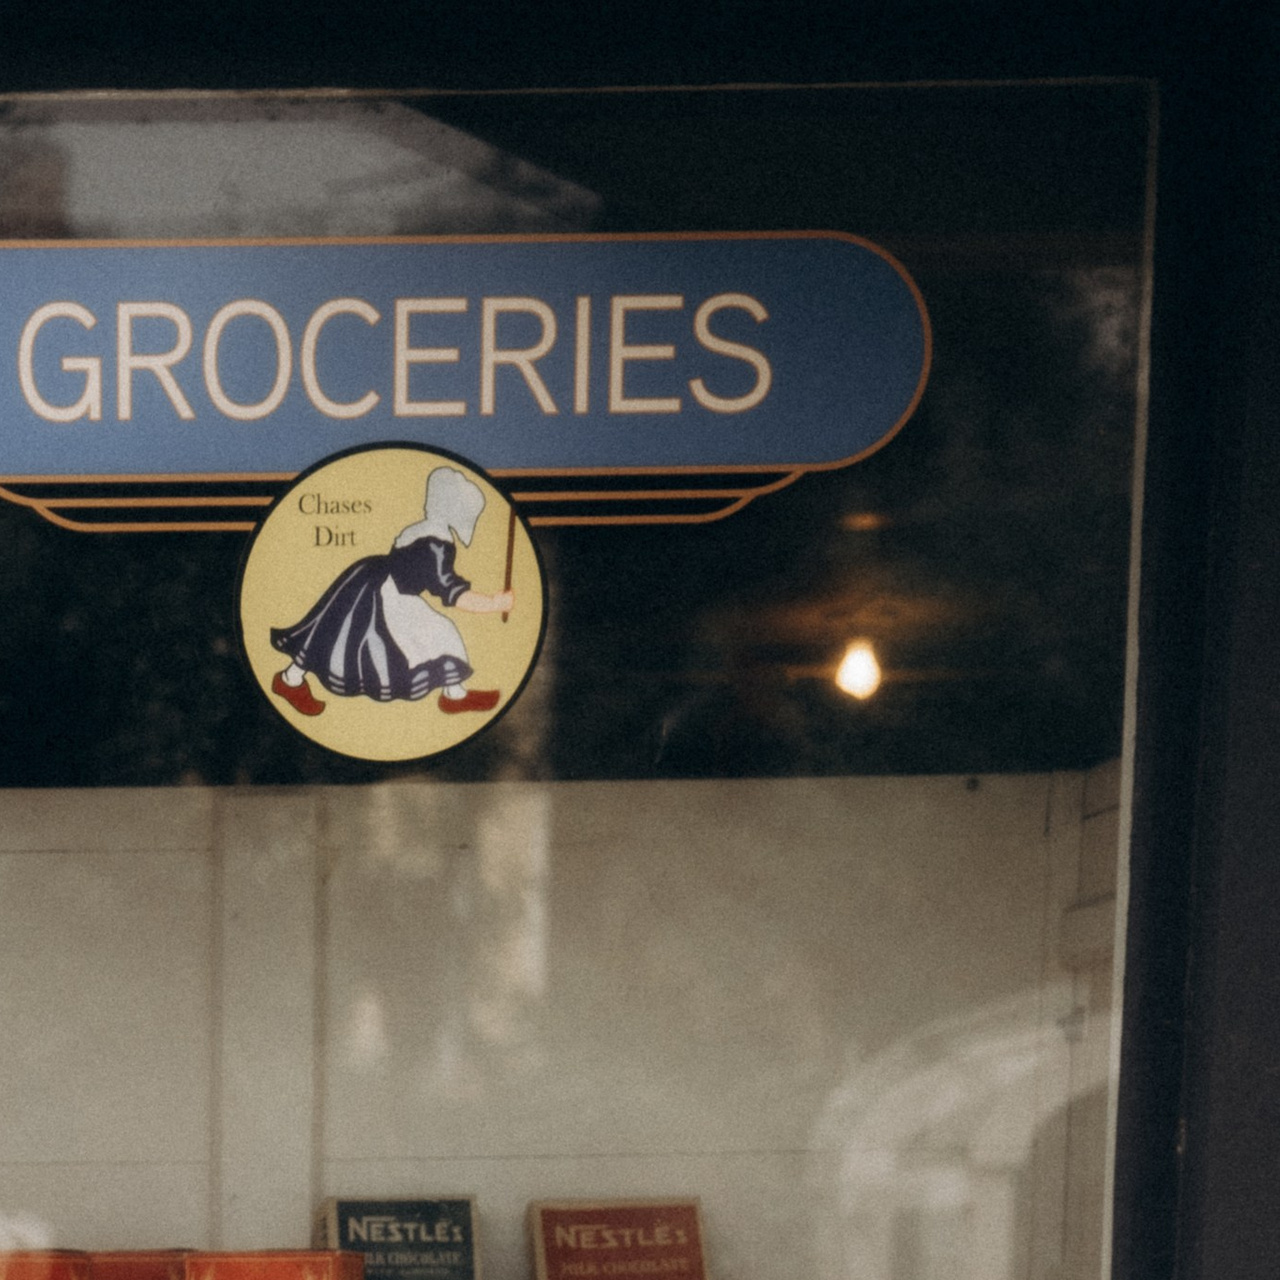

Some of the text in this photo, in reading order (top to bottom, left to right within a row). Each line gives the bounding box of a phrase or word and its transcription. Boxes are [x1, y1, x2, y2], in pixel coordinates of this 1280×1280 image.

[18, 293, 772, 422] GROCERIES
[298, 493, 372, 515] Chases
[314, 525, 357, 547] Dirt
